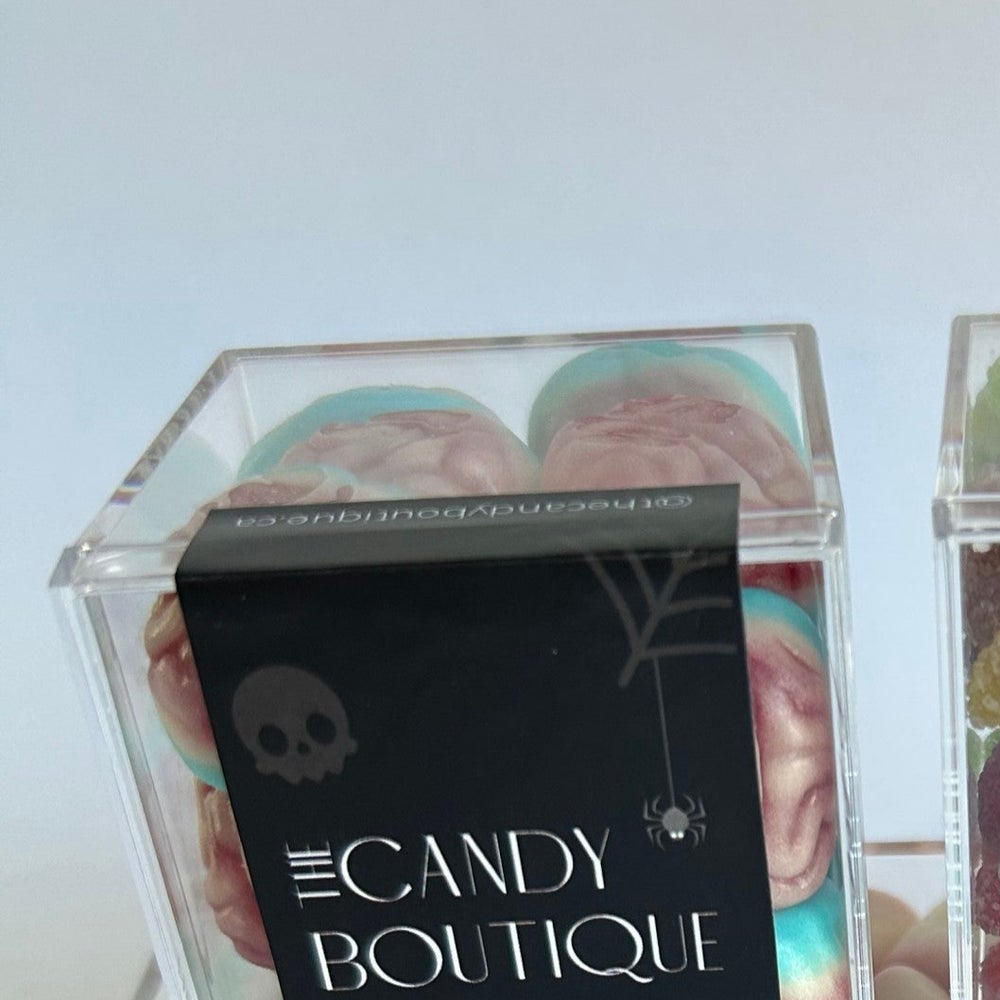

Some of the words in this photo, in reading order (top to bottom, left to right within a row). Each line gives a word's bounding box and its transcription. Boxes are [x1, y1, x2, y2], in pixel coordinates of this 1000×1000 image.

[235, 494, 695, 529] @thecandyboutique.ca
[284, 840, 342, 910] THE
[339, 826, 611, 903] CANDY
[311, 911, 725, 992] BOUTIQUE
